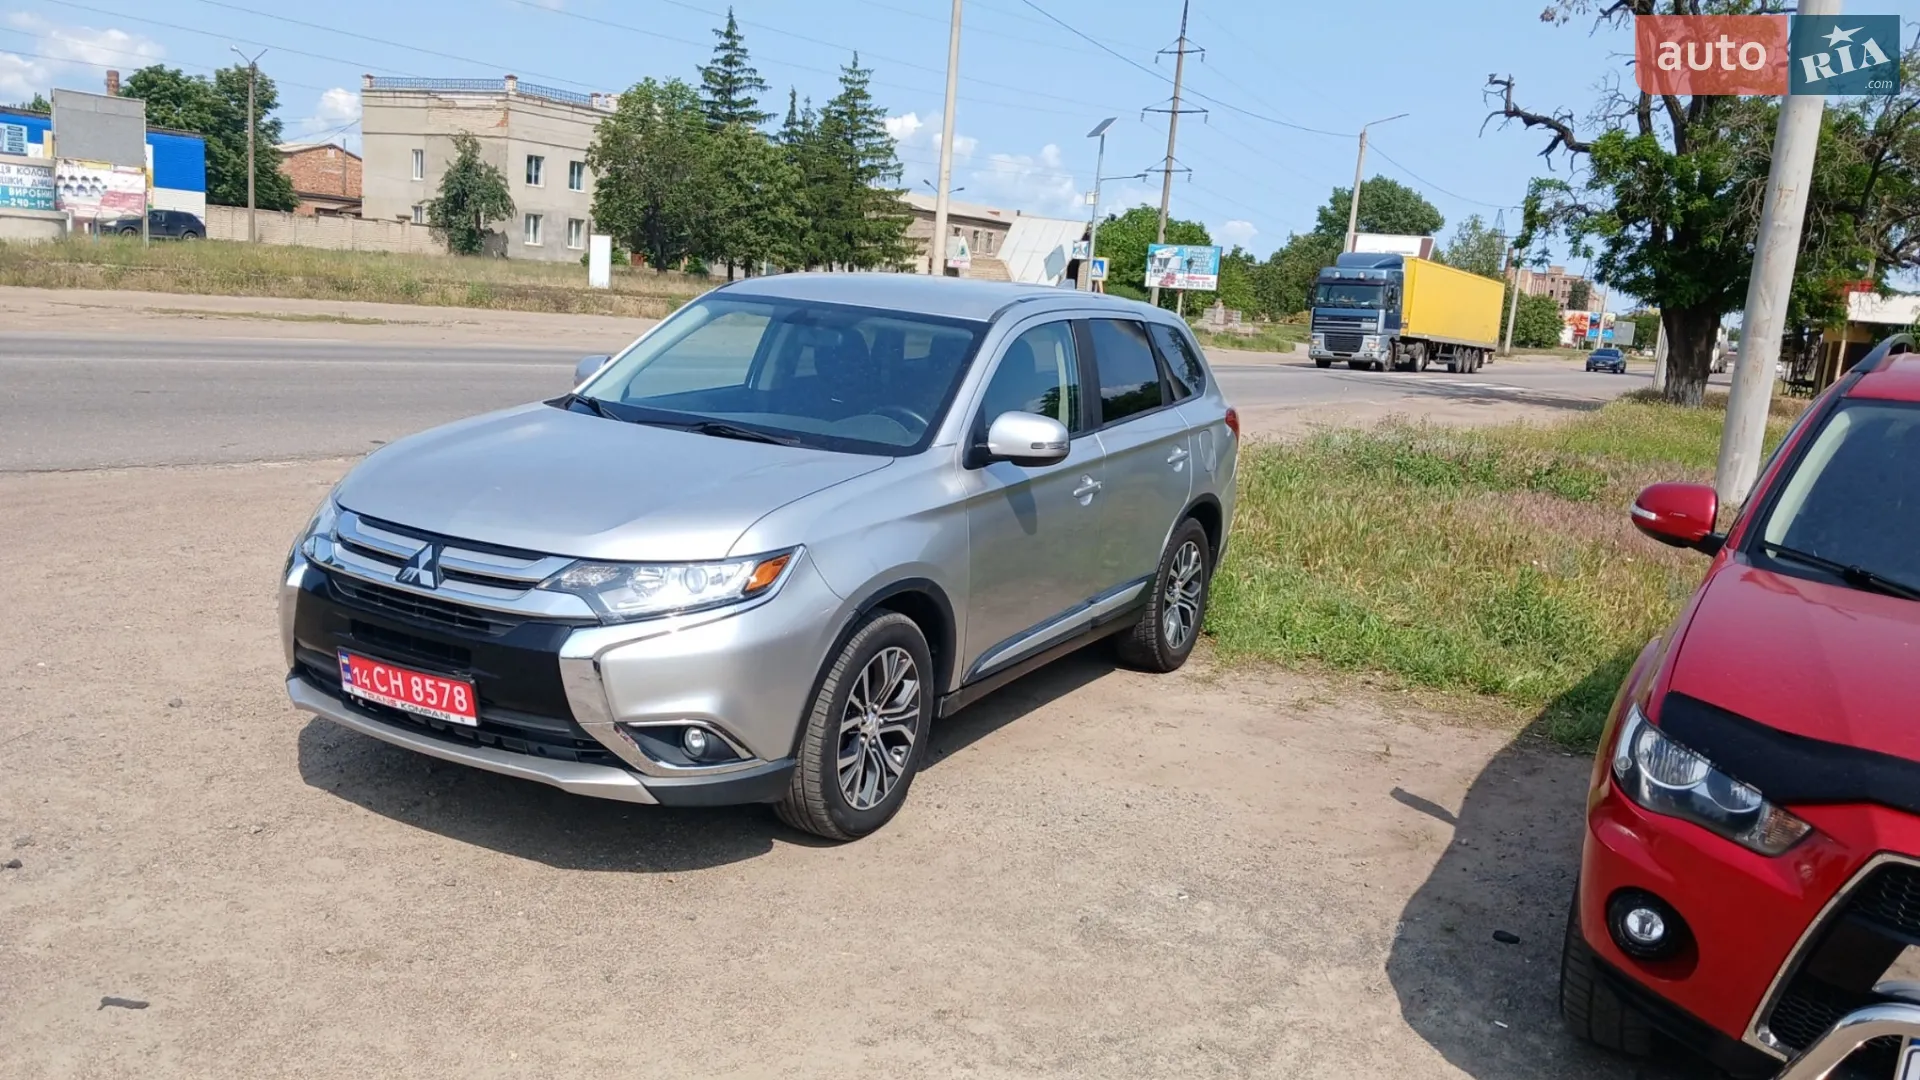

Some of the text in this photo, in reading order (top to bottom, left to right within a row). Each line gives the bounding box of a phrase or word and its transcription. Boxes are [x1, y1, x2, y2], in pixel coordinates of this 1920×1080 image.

[362, 690, 451, 720] TRANS KOMPANI
[410, 676, 468, 712] 8578
